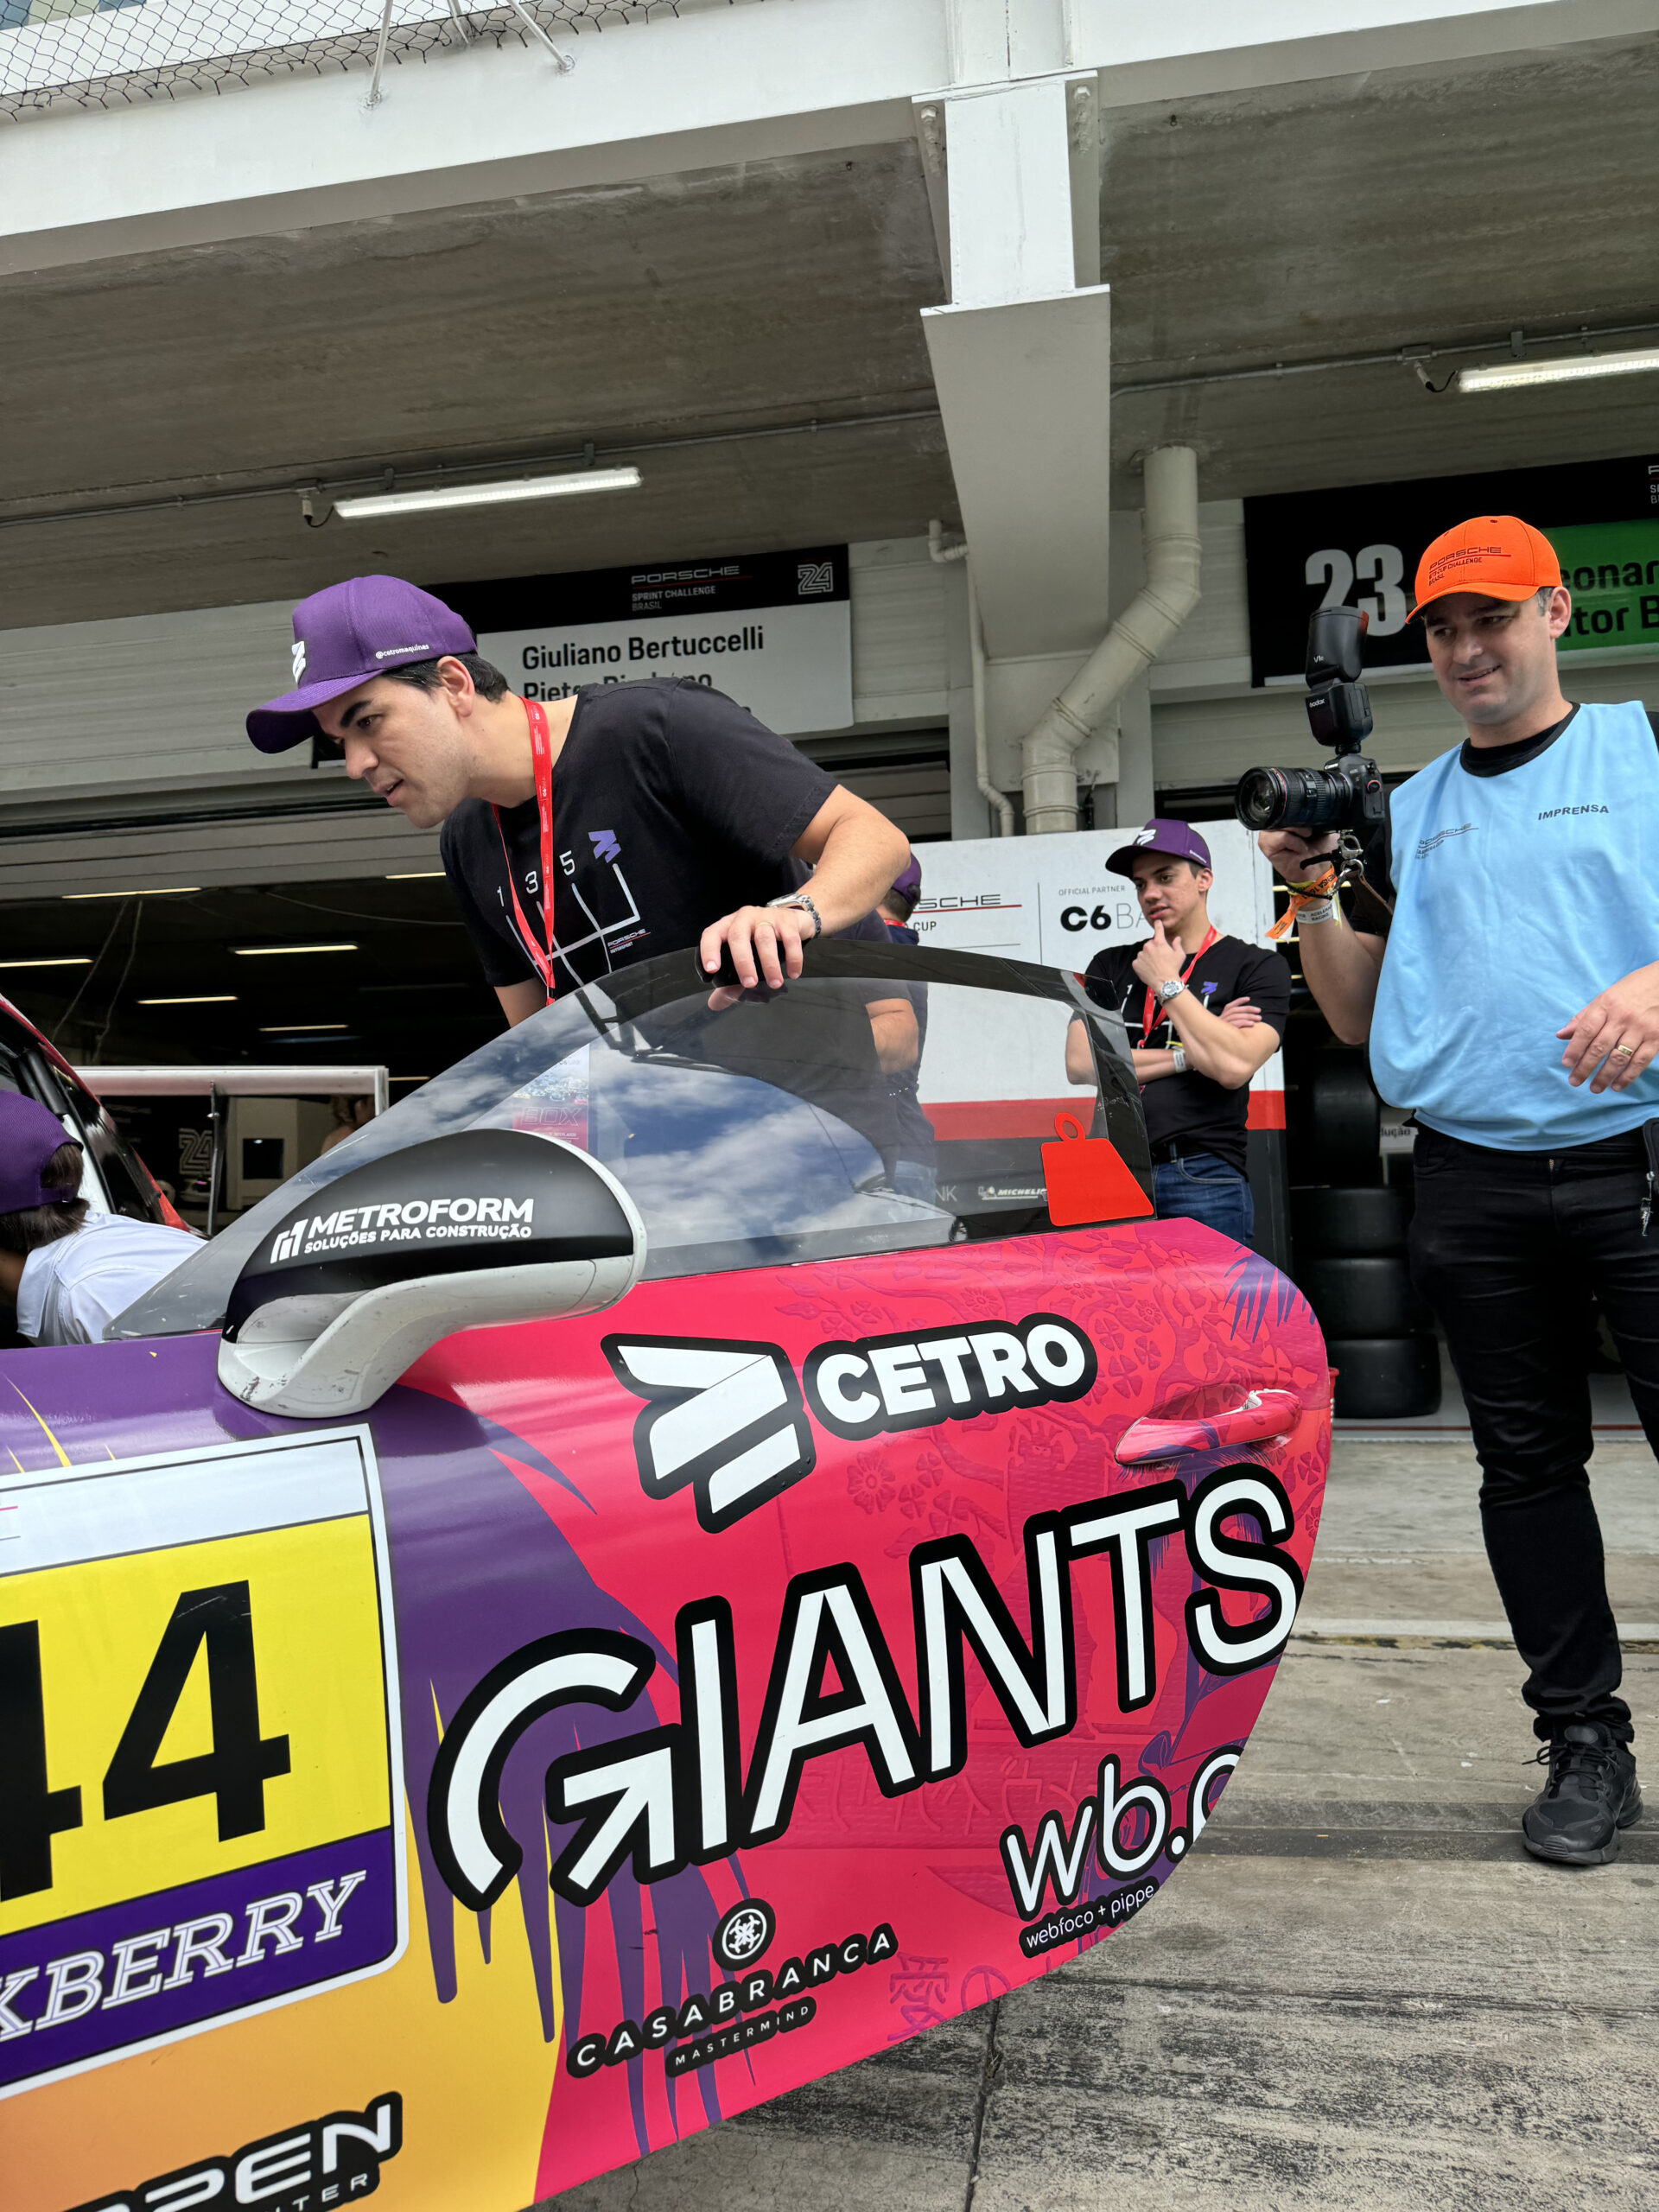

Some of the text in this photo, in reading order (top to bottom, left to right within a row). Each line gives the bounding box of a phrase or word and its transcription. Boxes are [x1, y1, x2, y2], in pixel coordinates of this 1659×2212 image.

[1429, 546, 1502, 570] PORSCHE
[1447, 556, 1483, 570] CHALLENGE
[632, 565, 740, 585] PORSCHE
[798, 563, 834, 595] 24
[1305, 543, 1407, 636] 23
[632, 585, 716, 602] SPRINT CHALLENGE
[632, 601, 663, 612] BRASIL
[523, 626, 765, 671] Giuliano Bertuccelli
[1538, 804, 1610, 821] IMPRENSA
[525, 871, 539, 894] 3
[559, 850, 575, 876] 5
[914, 893, 1001, 909] SCHE
[1058, 885, 1126, 896] OFFICIAL PARTNER
[913, 921, 937, 931] CUP
[1060, 905, 1112, 932] C6
[308, 1198, 534, 1239] METROFORM
[304, 1223, 533, 1254] SOLUÇÕES PARA CONSTRUÇÃO
[815, 1324, 1087, 1424] CETRO
[446, 1478, 1296, 1893] GIANTS
[1027, 1910, 1094, 1948] webfoco
[1110, 1884, 1154, 1916] pippe
[576, 1932, 891, 2067] CASABRANCA
[675, 2005, 810, 2066] MASTERMIND
[97, 2103, 391, 2212] PEN
